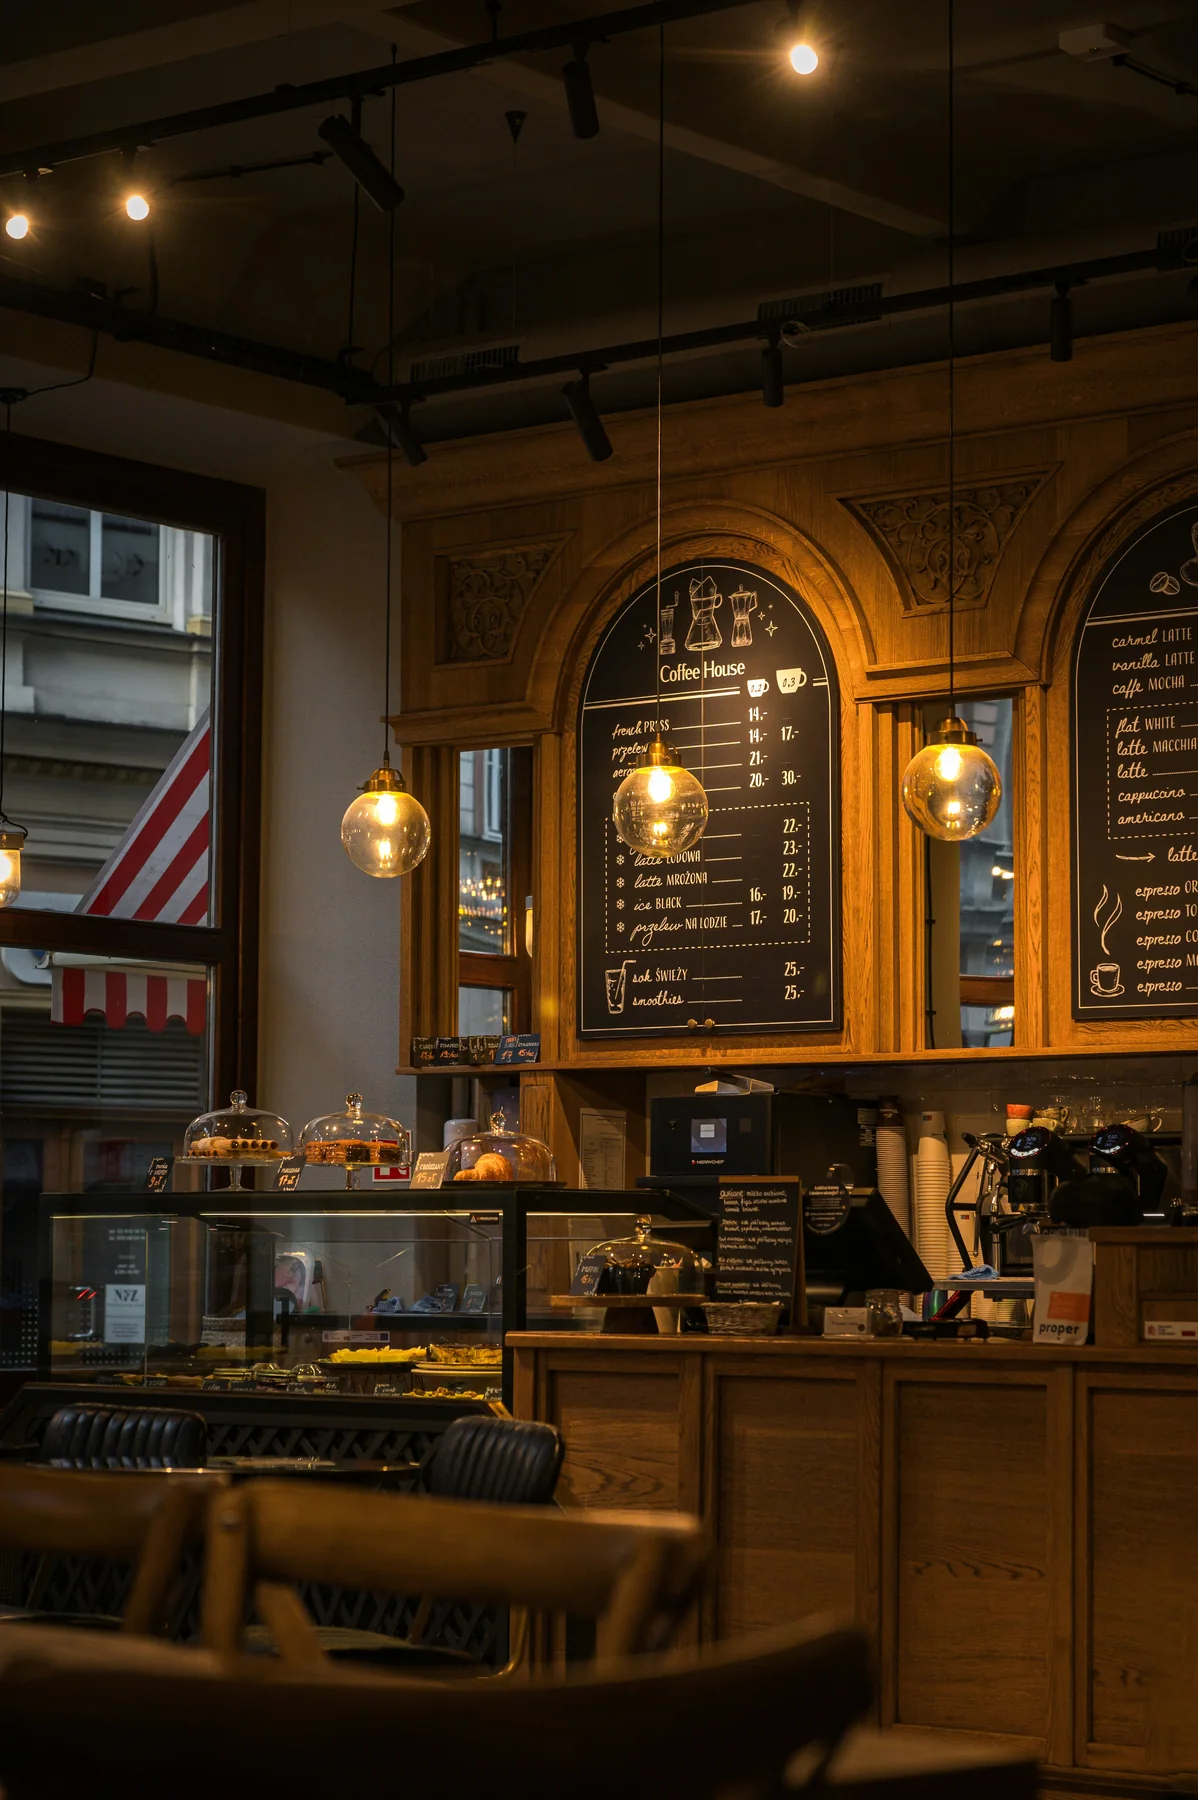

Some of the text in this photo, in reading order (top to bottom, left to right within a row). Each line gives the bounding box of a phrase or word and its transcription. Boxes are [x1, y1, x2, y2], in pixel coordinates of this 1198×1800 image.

[1112, 627, 1193, 648] carmel LATTE
[1112, 651, 1195, 672] vanilla LATTE
[660, 660, 746, 683] Coffee House
[782, 677, 796, 688] 0.3
[1112, 674, 1185, 699] caffe MOCHA
[612, 720, 642, 740] french
[644, 719, 670, 733] PRSS
[1115, 716, 1176, 738] flat WHITE
[612, 742, 649, 762] przelew
[781, 726, 799, 741] 17,-
[1116, 736, 1198, 756] latte MACCHIA
[1116, 764, 1149, 780] latte
[1118, 786, 1186, 804] cappuccino
[783, 818, 802, 834] 22,-
[1118, 810, 1185, 825] americano
[782, 840, 802, 856] 23,-
[1167, 845, 1198, 862] latte
[634, 862, 802, 888] latte MROŻONA 22,-
[634, 884, 801, 910] ice BLACK 16,- 19,-
[1135, 884, 1180, 902] espresso
[1136, 908, 1181, 926] espresso
[630, 908, 803, 947] przelew NA LODZIE 17,- 20,-
[1136, 932, 1182, 950] espresso
[655, 967, 688, 982] ŚWIEŻY
[784, 962, 805, 976] 25,-
[1136, 958, 1182, 974] espresso
[632, 984, 805, 1006] smoothies 25,-
[1136, 980, 1182, 998] espresso
[1040, 1323, 1080, 1336] proper
